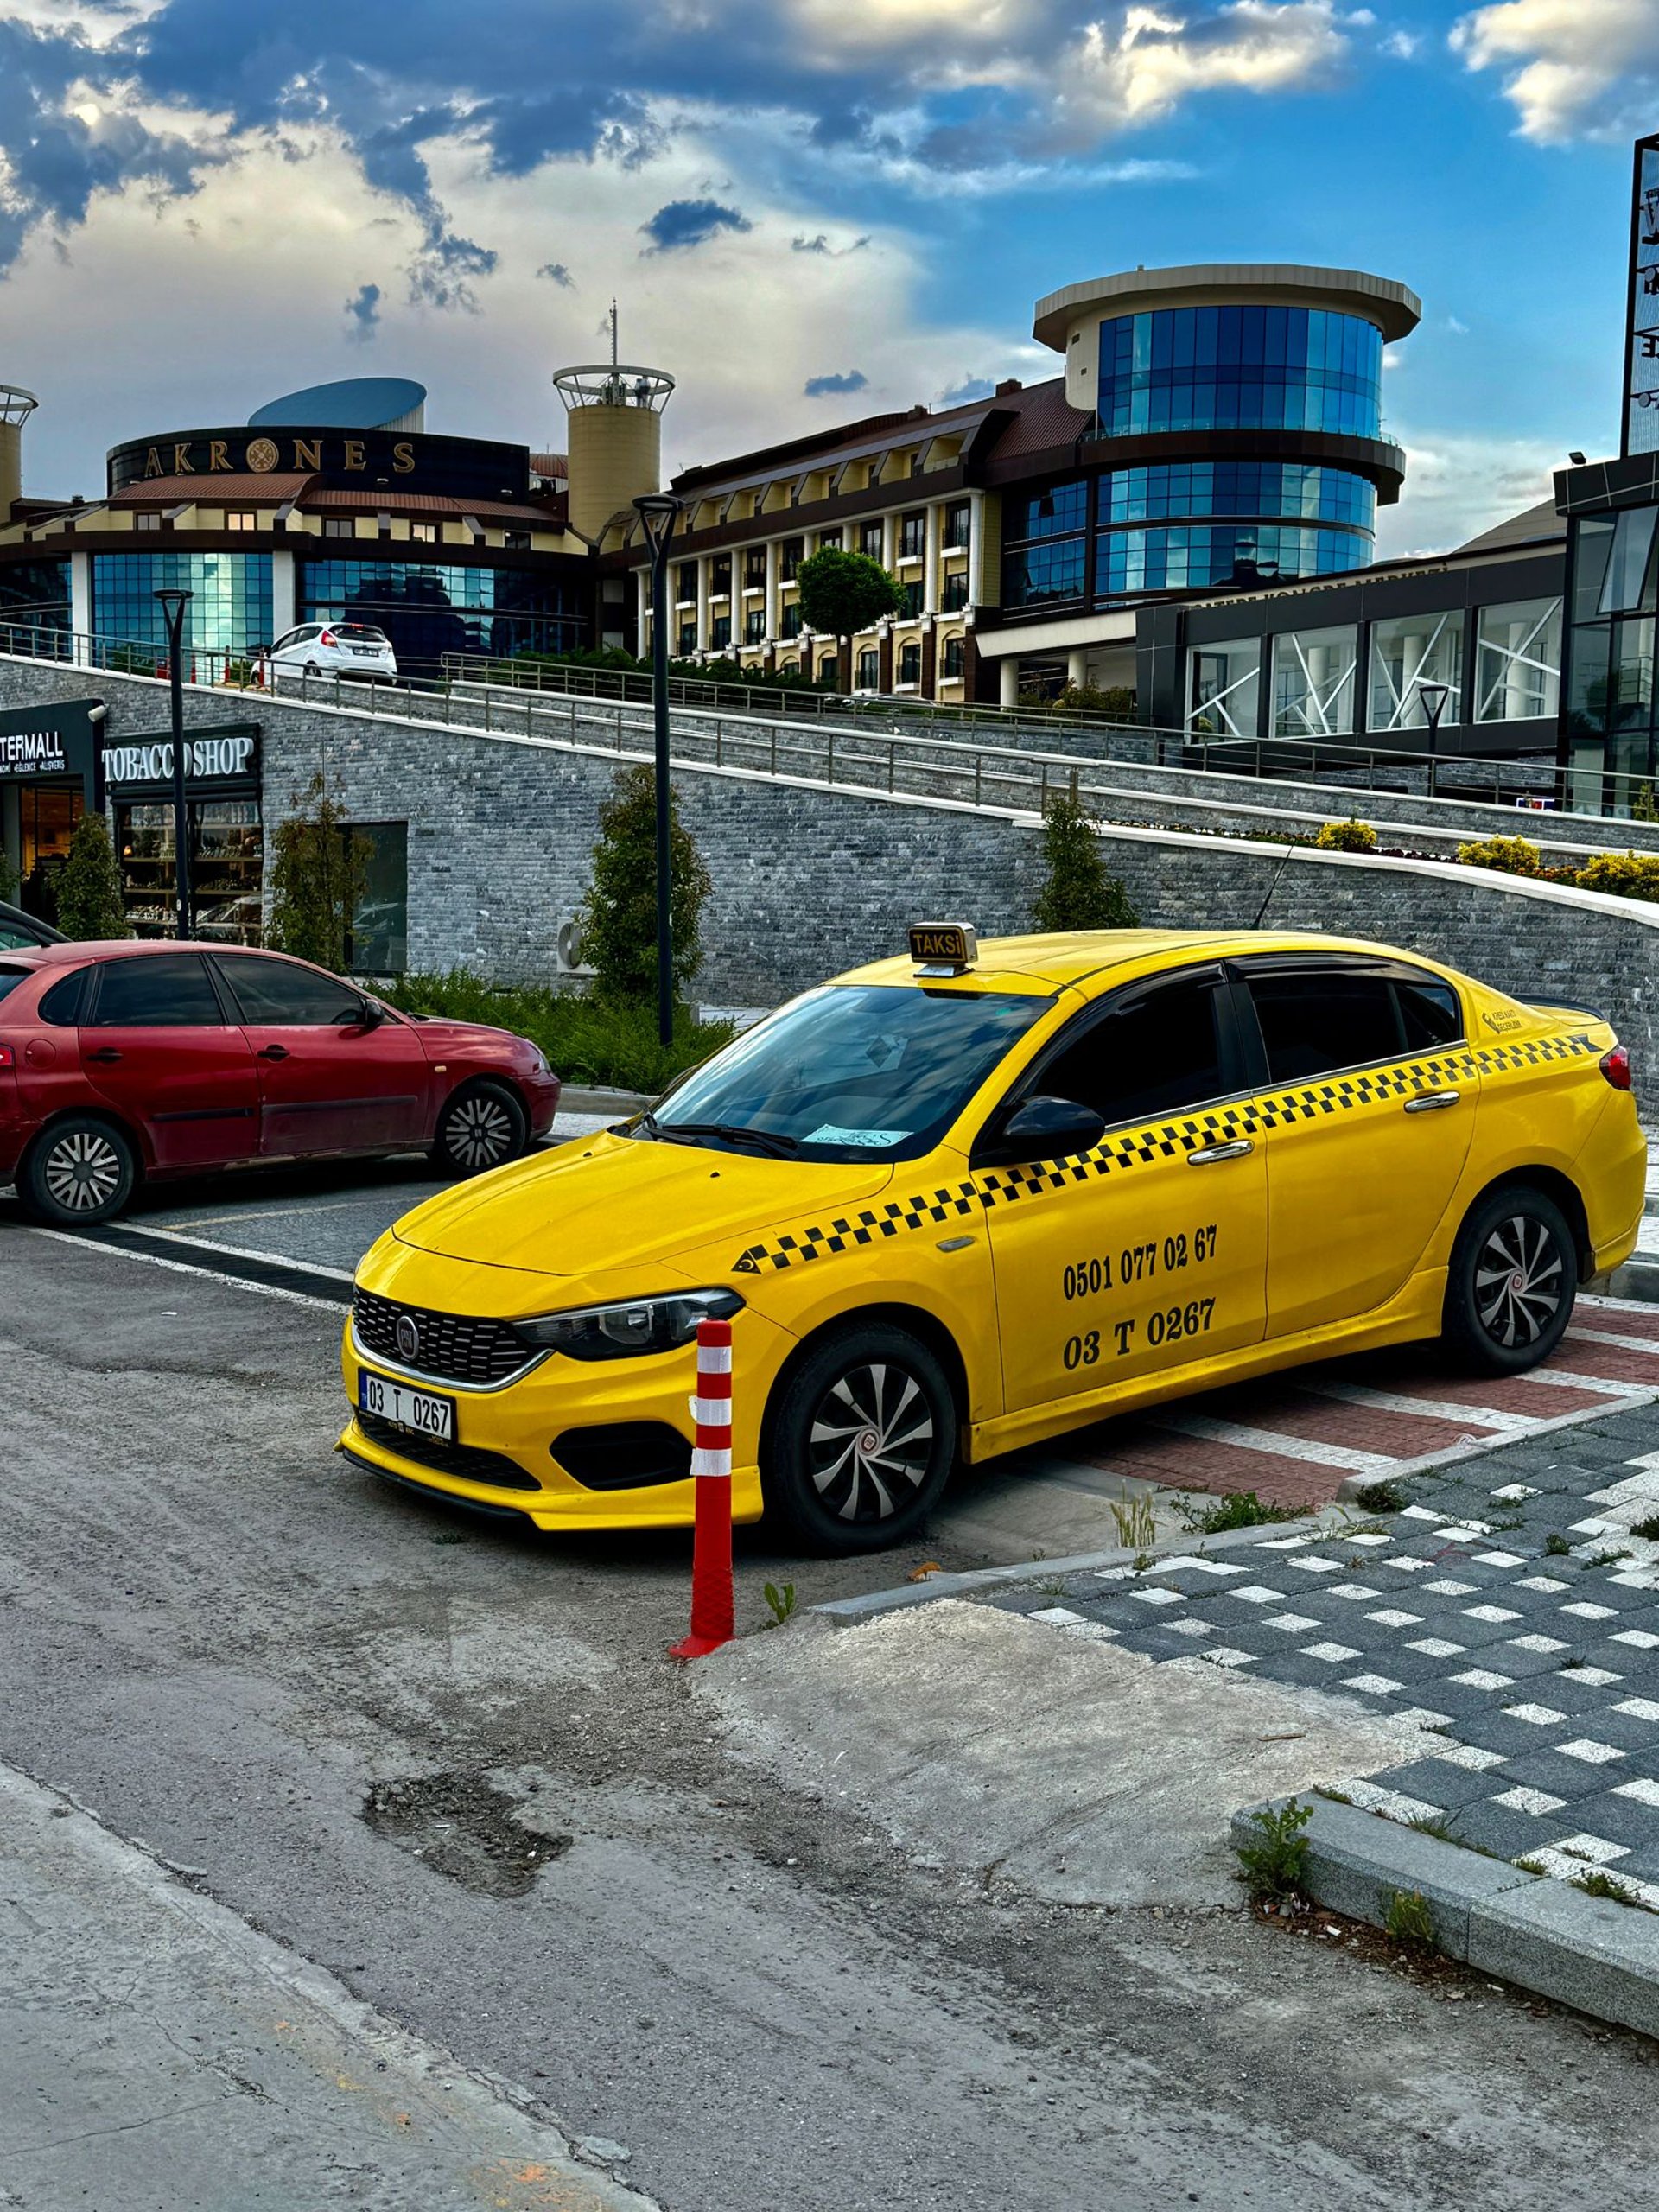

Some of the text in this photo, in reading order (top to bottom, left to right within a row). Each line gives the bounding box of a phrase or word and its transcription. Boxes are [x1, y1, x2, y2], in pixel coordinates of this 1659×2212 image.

[0, 731, 64, 762] TERMALL
[193, 737, 254, 777] SHOP
[1063, 1224, 1217, 1301] 0501 077 02 67
[1063, 1296, 1217, 1370] 03 T 0267
[369, 1380, 384, 1413] 03
[393, 1389, 402, 1419] T
[413, 1395, 448, 1435] 0267
